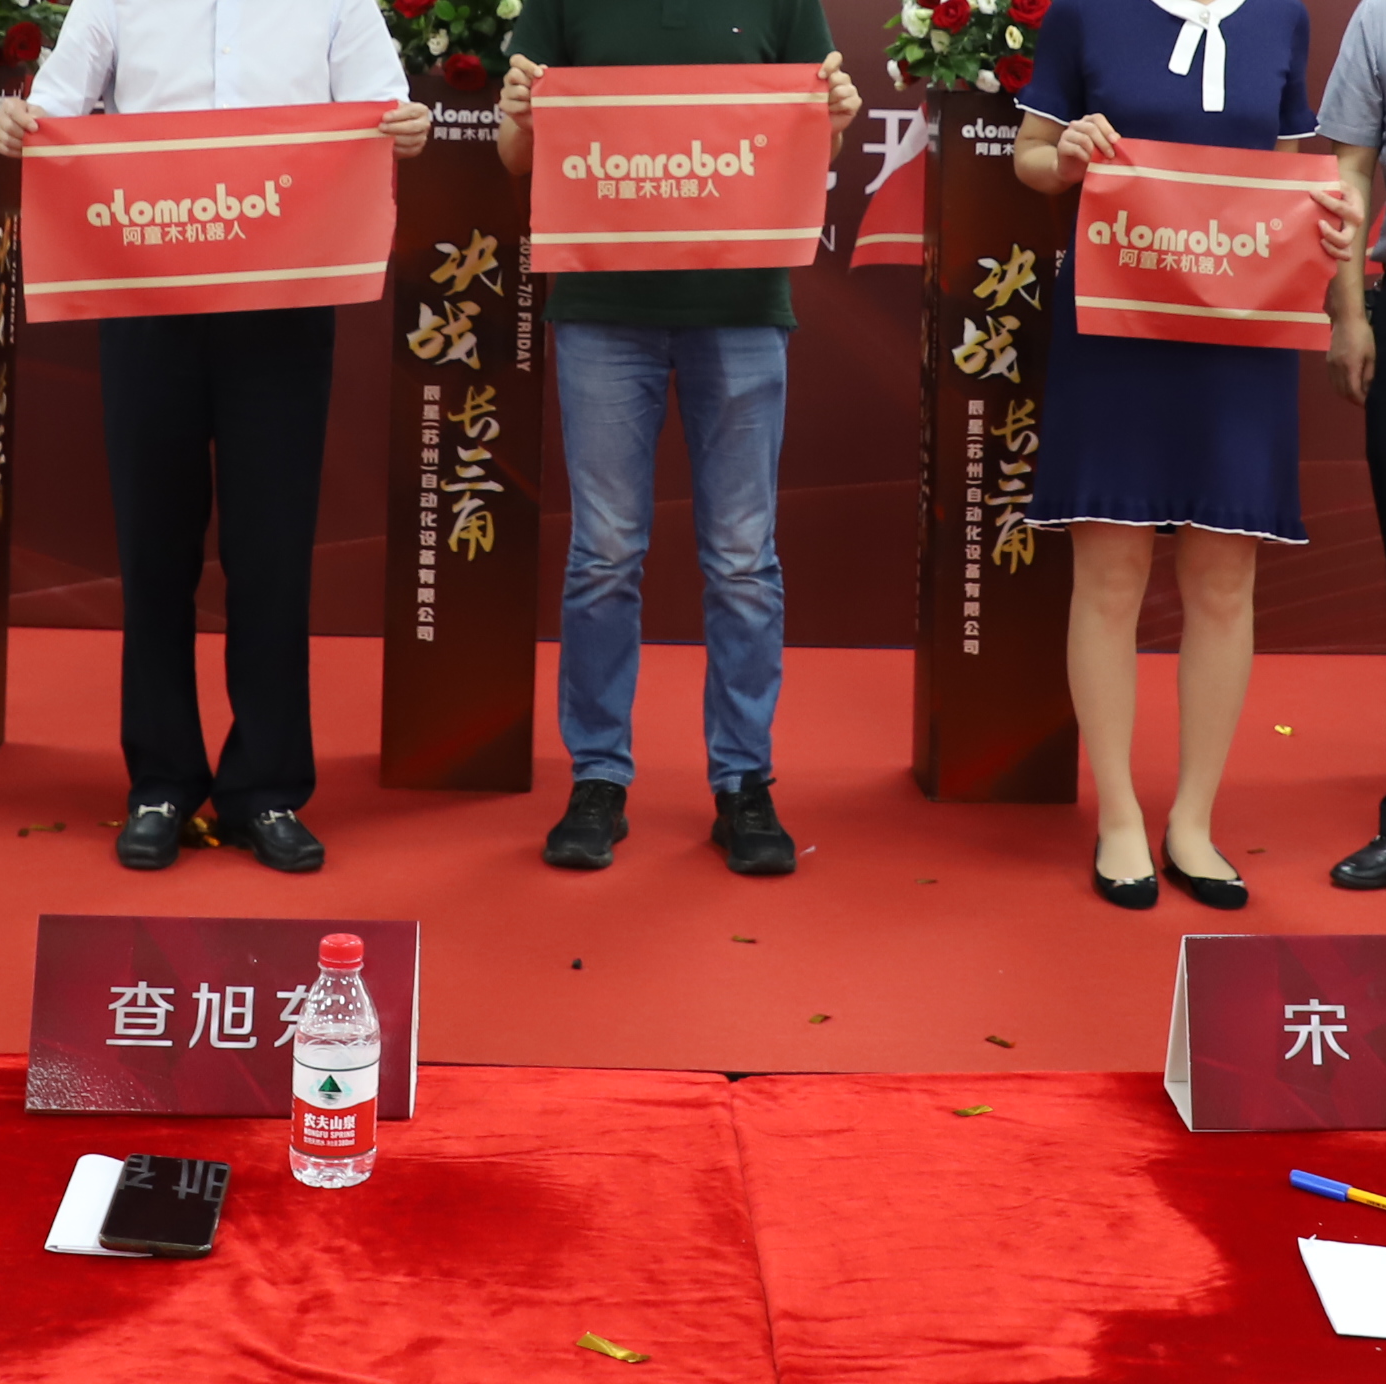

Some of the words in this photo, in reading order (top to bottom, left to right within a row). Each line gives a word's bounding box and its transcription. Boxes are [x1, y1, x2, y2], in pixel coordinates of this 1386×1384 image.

[562, 139, 755, 179] atomrobot
[975, 142, 1015, 156] 阿童木
[87, 180, 281, 227] atomrobot
[597, 178, 720, 199] 阿童木机器人
[122, 220, 246, 246] 阿童木机器人
[1088, 210, 1270, 258] atomrobot
[1119, 248, 1235, 277] 阿童木机器人
[406, 228, 504, 370] 决战
[952, 243, 1042, 384] 决战
[516, 312, 532, 372] FRIDAY
[440, 385, 504, 561] 长三角
[304, 1113, 356, 1130] 农夫山泉
[330, 1130, 356, 1139] SPRING
